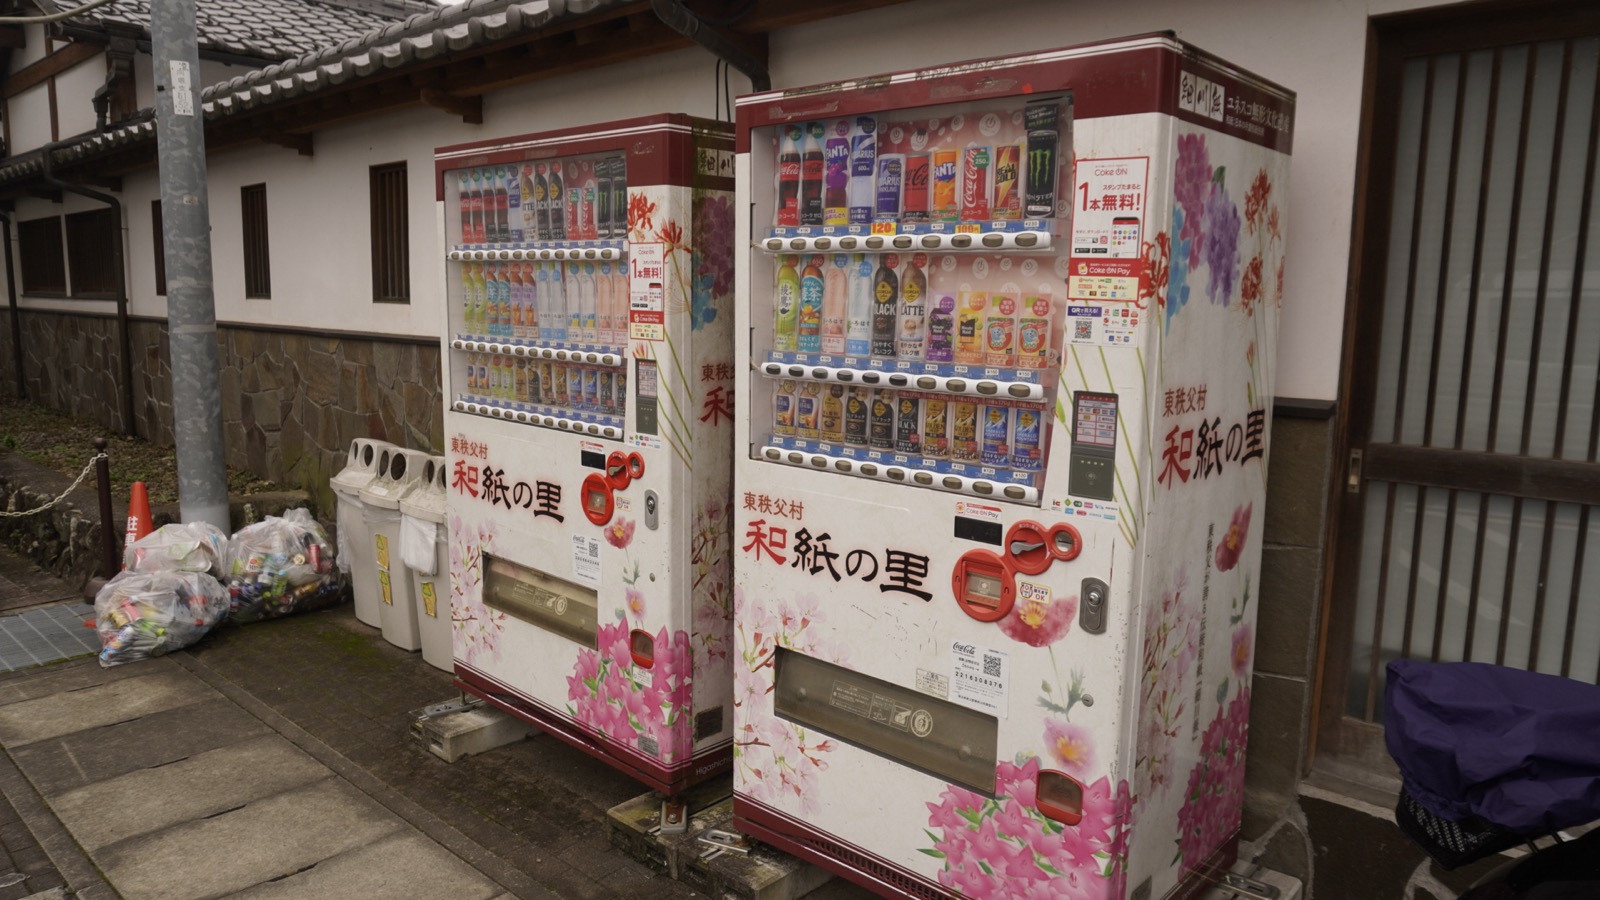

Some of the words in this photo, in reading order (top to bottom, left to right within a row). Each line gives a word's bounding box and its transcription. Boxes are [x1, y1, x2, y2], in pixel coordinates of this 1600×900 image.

[1163, 383, 1207, 417] 東秩父村
[451, 437, 488, 460] 東秩父村
[1158, 408, 1265, 491] 和紙の里
[452, 460, 565, 523] 和紙の里
[743, 491, 804, 520] 東秩父村
[742, 519, 933, 602] 和紙の里
